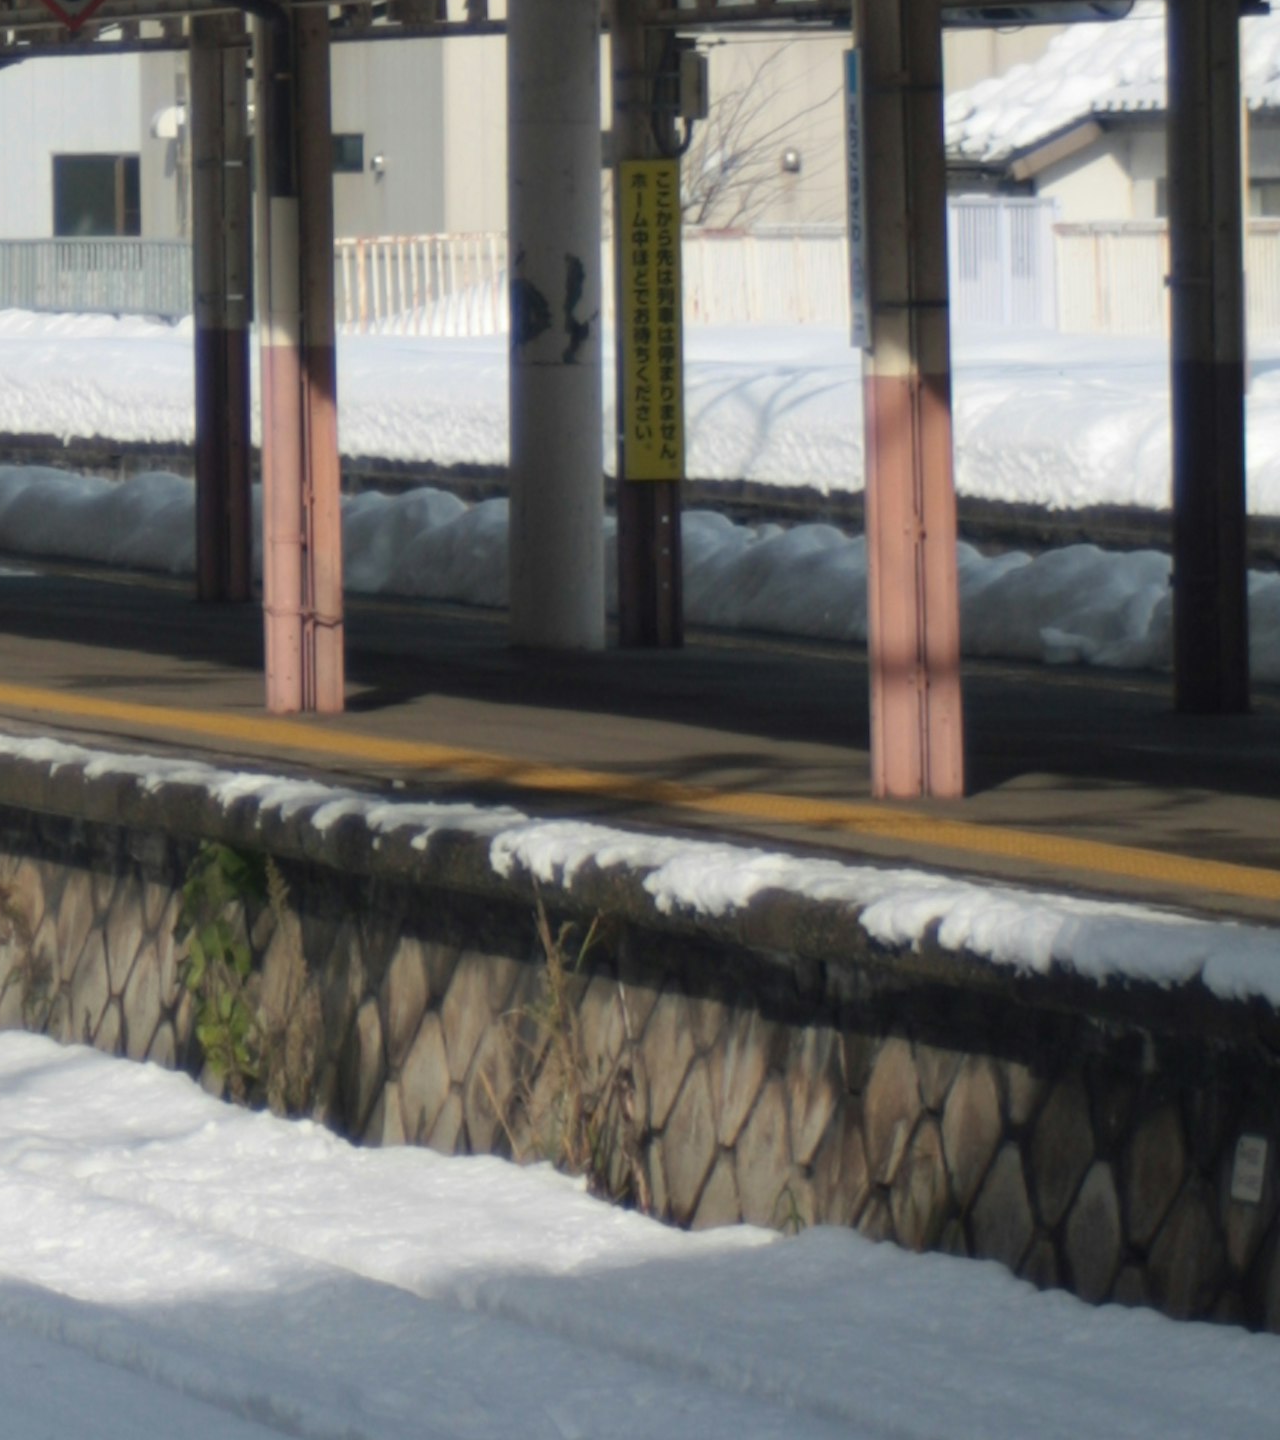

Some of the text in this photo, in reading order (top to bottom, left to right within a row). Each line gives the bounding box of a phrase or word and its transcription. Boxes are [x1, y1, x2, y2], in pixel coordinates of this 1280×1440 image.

[630, 173, 652, 450] ホーム中ほどでお待ちください。
[655, 171, 677, 470] ここから先は列車は停まりません。
